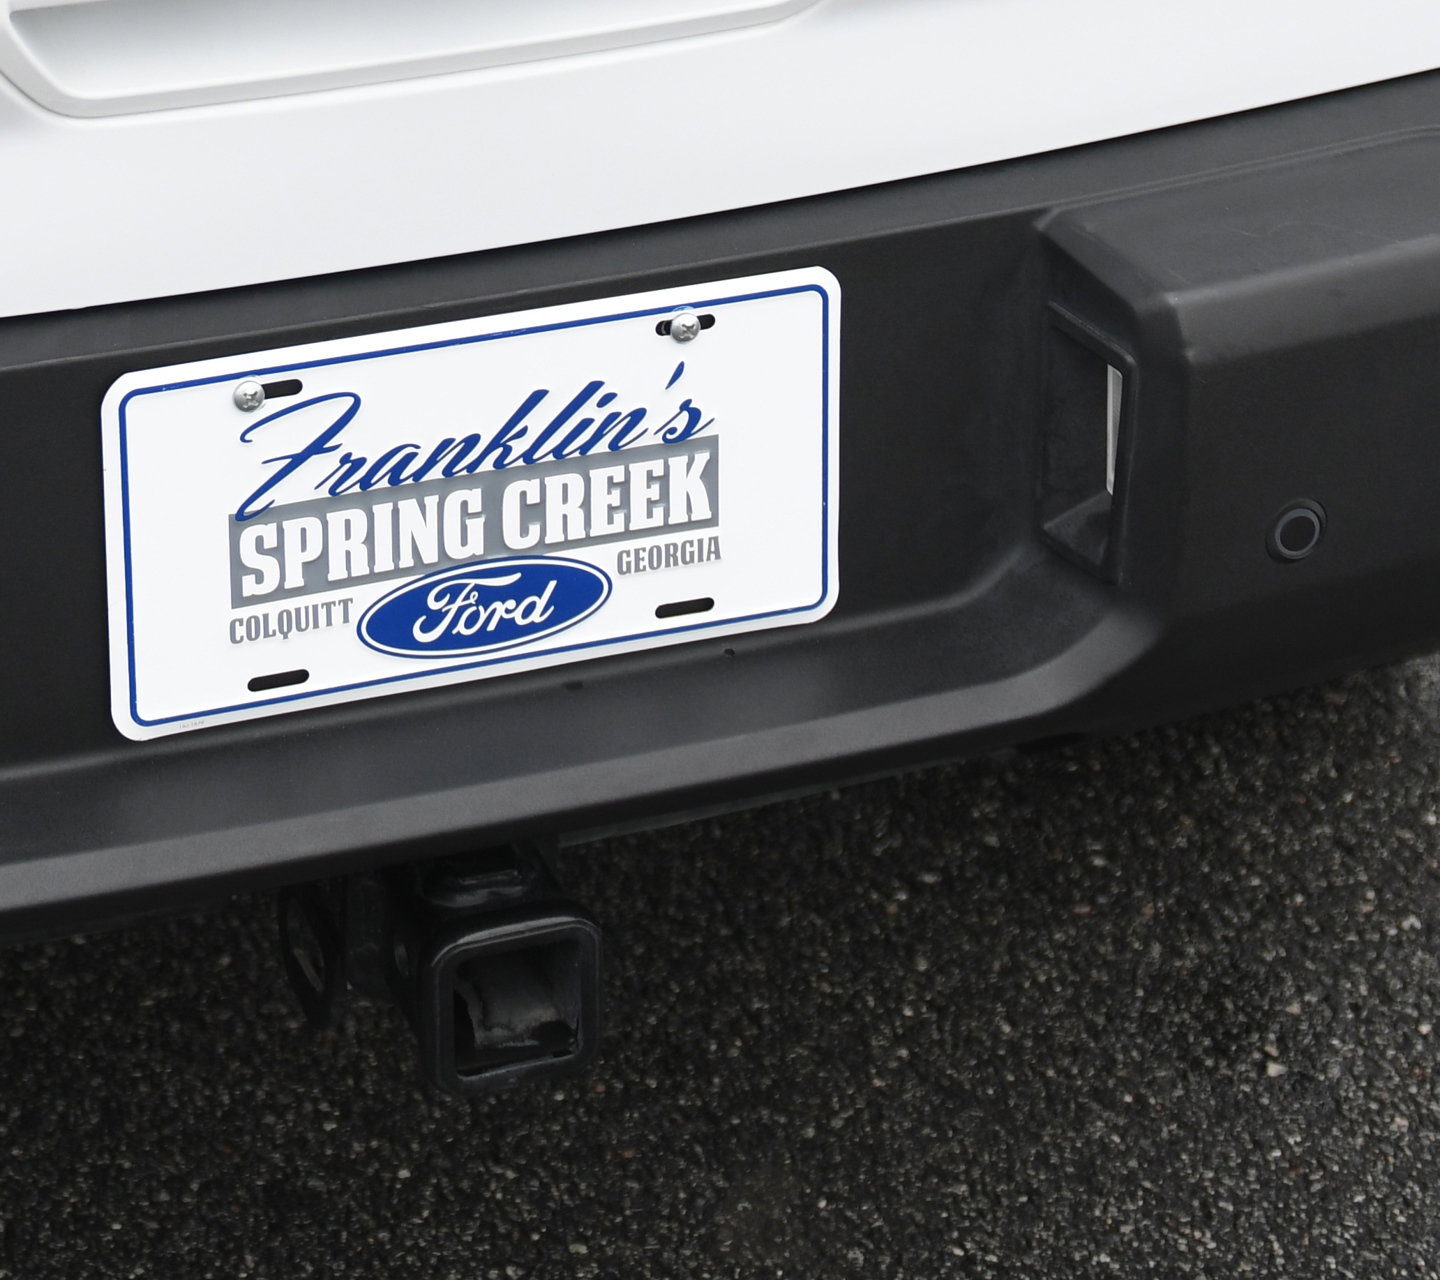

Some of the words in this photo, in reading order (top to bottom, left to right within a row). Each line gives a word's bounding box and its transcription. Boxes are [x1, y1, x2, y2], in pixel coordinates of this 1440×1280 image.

[235, 360, 717, 522] Franklin's
[238, 486, 487, 598] SPRING
[502, 450, 713, 552] CREEK
[229, 597, 354, 645] COLQUITT
[616, 536, 722, 576] GEORGIA
[412, 575, 554, 643] Ford
